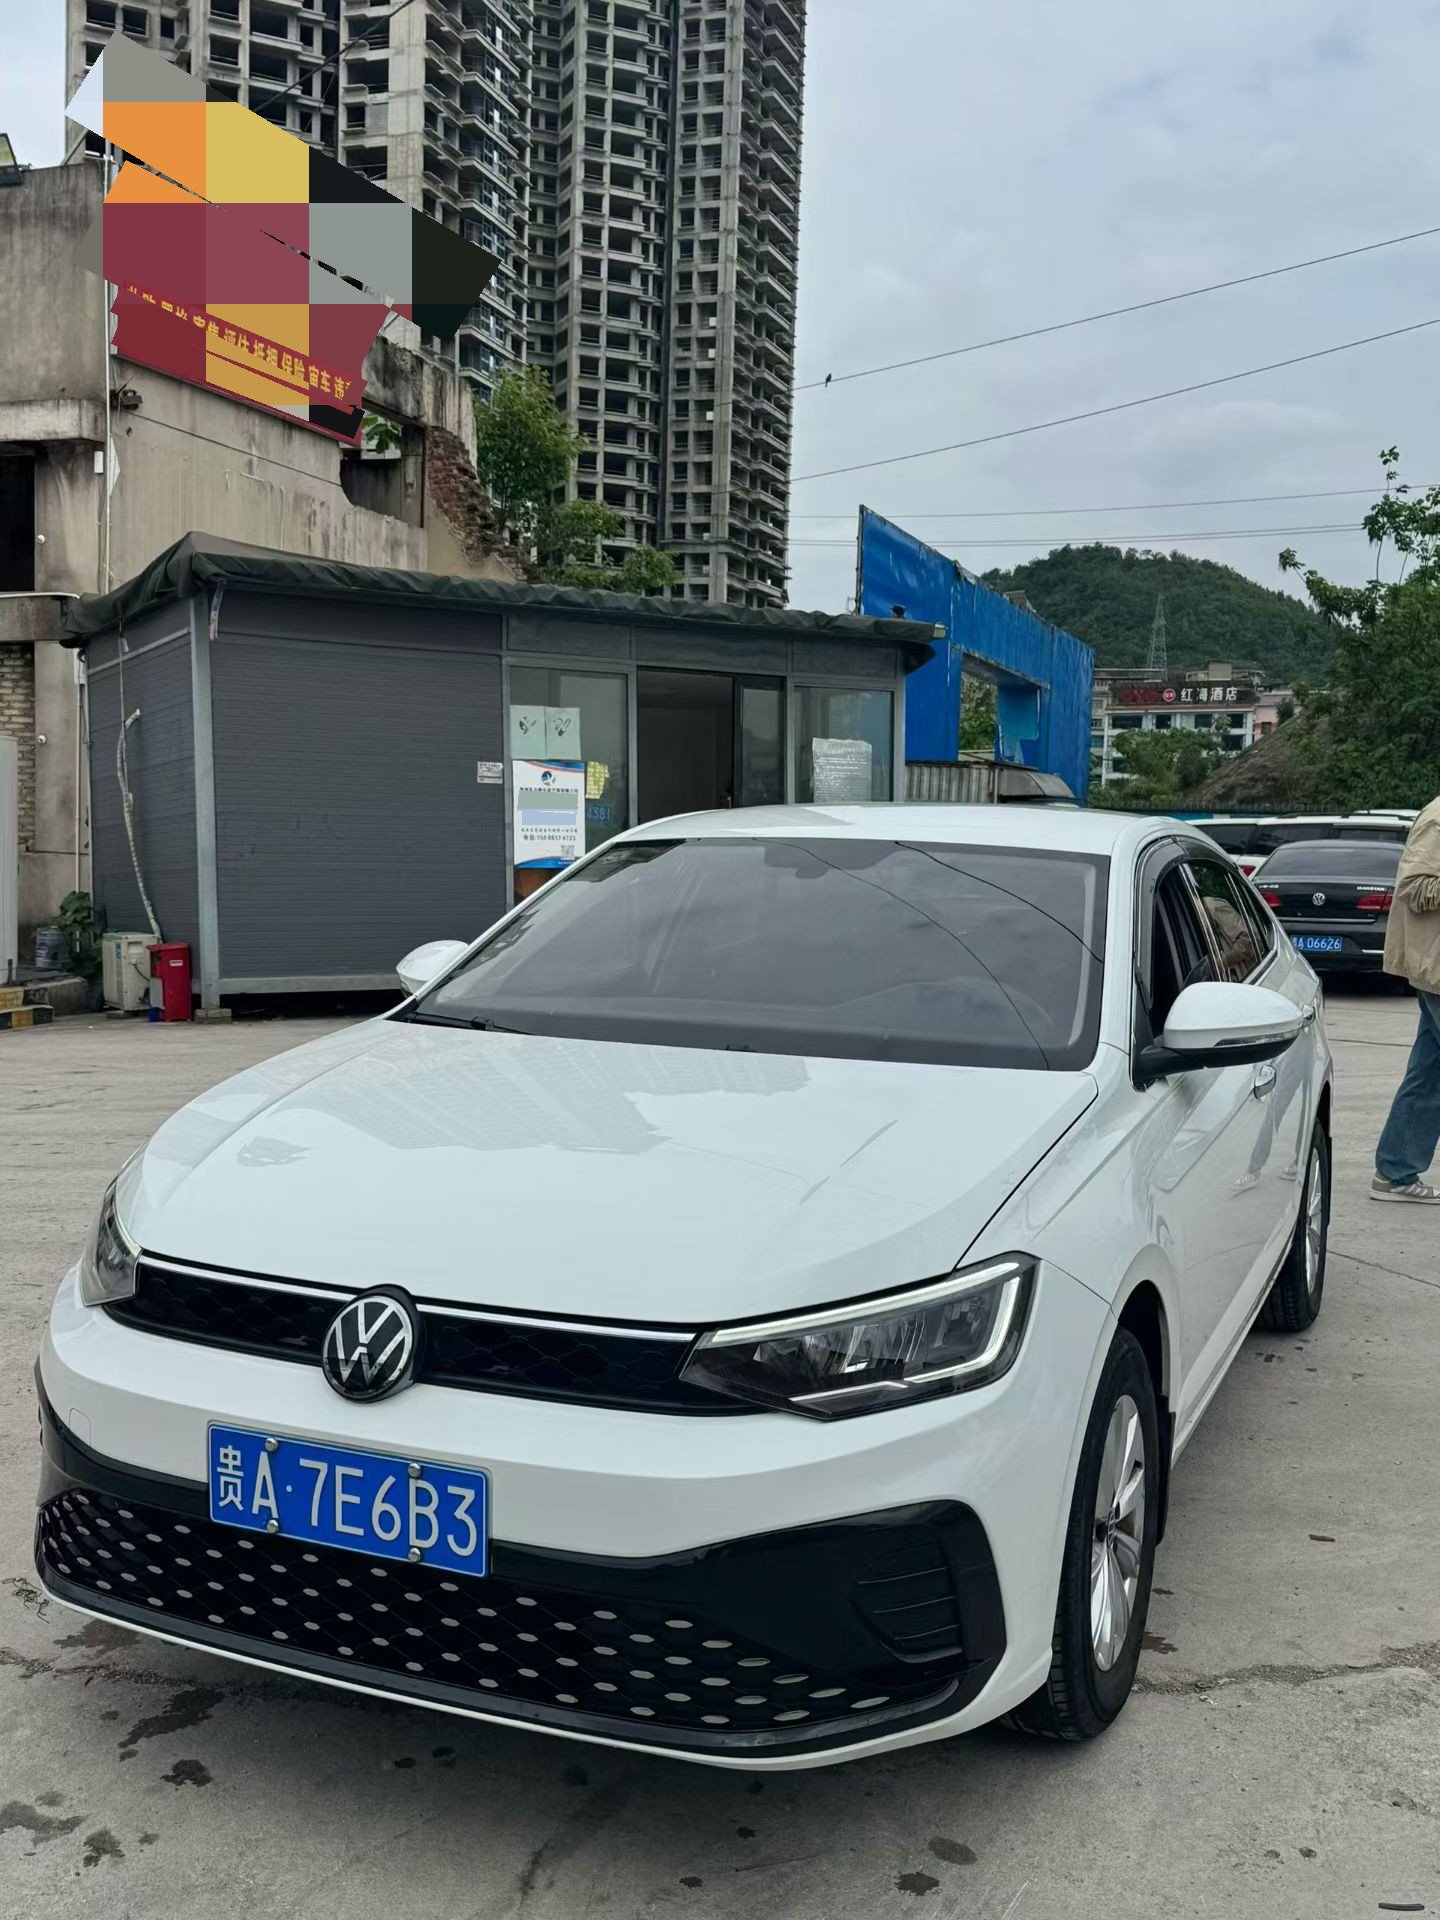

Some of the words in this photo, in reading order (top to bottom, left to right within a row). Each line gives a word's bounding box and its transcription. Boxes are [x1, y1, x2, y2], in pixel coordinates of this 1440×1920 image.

[1180, 686, 1238, 702] 红海酒店
[216, 1444, 478, 1557] 贵A·7E6B3
